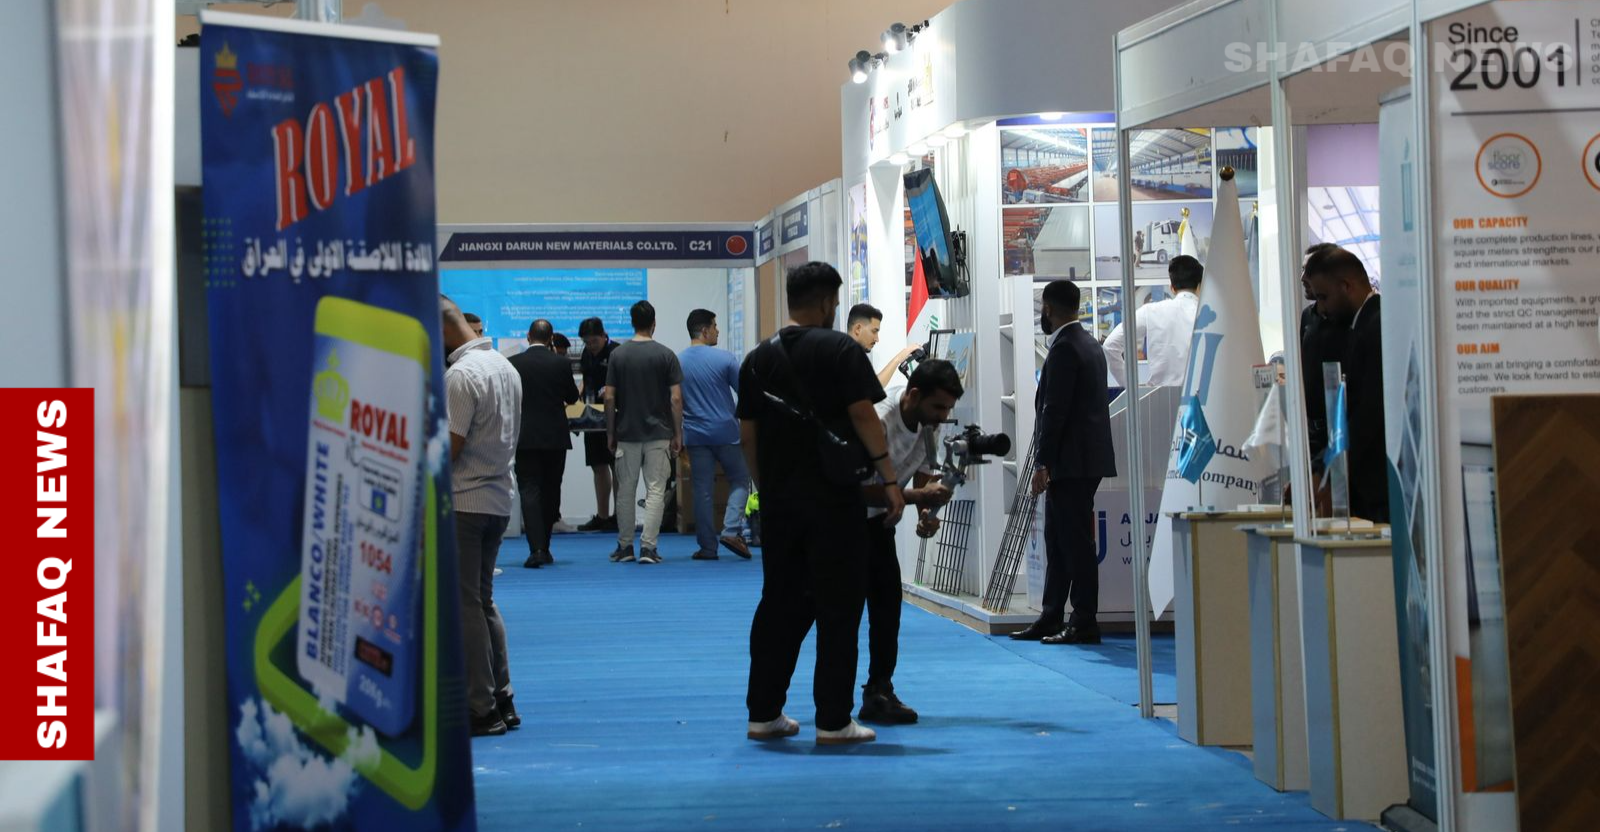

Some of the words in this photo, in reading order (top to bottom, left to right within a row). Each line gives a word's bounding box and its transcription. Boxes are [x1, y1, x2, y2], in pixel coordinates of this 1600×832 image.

[1448, 22, 1518, 44] Since
[1450, 45, 1565, 91] 2001
[271, 66, 416, 232] ROYAL
[1453, 218, 1474, 229] OUR
[1478, 216, 1528, 229] CAPACITY
[1453, 235, 1473, 245] Five
[1475, 234, 1518, 245] complete
[1519, 232, 1569, 245] production
[458, 242, 503, 252] JIANGXI
[505, 242, 543, 251] DARUN
[546, 241, 571, 251] NEW
[573, 240, 634, 251] MATERIALS
[636, 240, 678, 251] CO.LTD.
[689, 240, 712, 251] C21
[1454, 248, 1486, 258] square
[1487, 247, 1520, 256] meters
[1521, 246, 1576, 257] strengthens
[1454, 260, 1472, 269] and
[1473, 258, 1530, 268] international
[1455, 280, 1476, 291] OUR
[1478, 279, 1520, 292] QUALITY
[1455, 297, 1477, 307] With
[1478, 297, 1519, 308] imported
[1456, 309, 1473, 319] and
[1475, 309, 1490, 318] the
[1492, 308, 1515, 318] strict
[1516, 308, 1532, 317] QC
[1456, 322, 1479, 332] been
[1481, 321, 1532, 330] maintained
[1534, 320, 1544, 329] at
[1554, 319, 1575, 330] high
[1456, 343, 1478, 355] OUR
[1480, 342, 1500, 354] AIM
[1457, 360, 1473, 370] We
[1475, 361, 1492, 370] aim
[1494, 360, 1504, 369] at
[1505, 359, 1543, 370] bringing
[1553, 357, 1600, 367] comfortab
[1493, 372, 1510, 381] We
[1511, 371, 1531, 380] look
[1534, 370, 1569, 380] forward
[1570, 371, 1580, 379] to
[350, 399, 410, 450] ROYAL
[1202, 470, 1259, 496] ompany
[306, 440, 330, 660] BLANCO/WHITE
